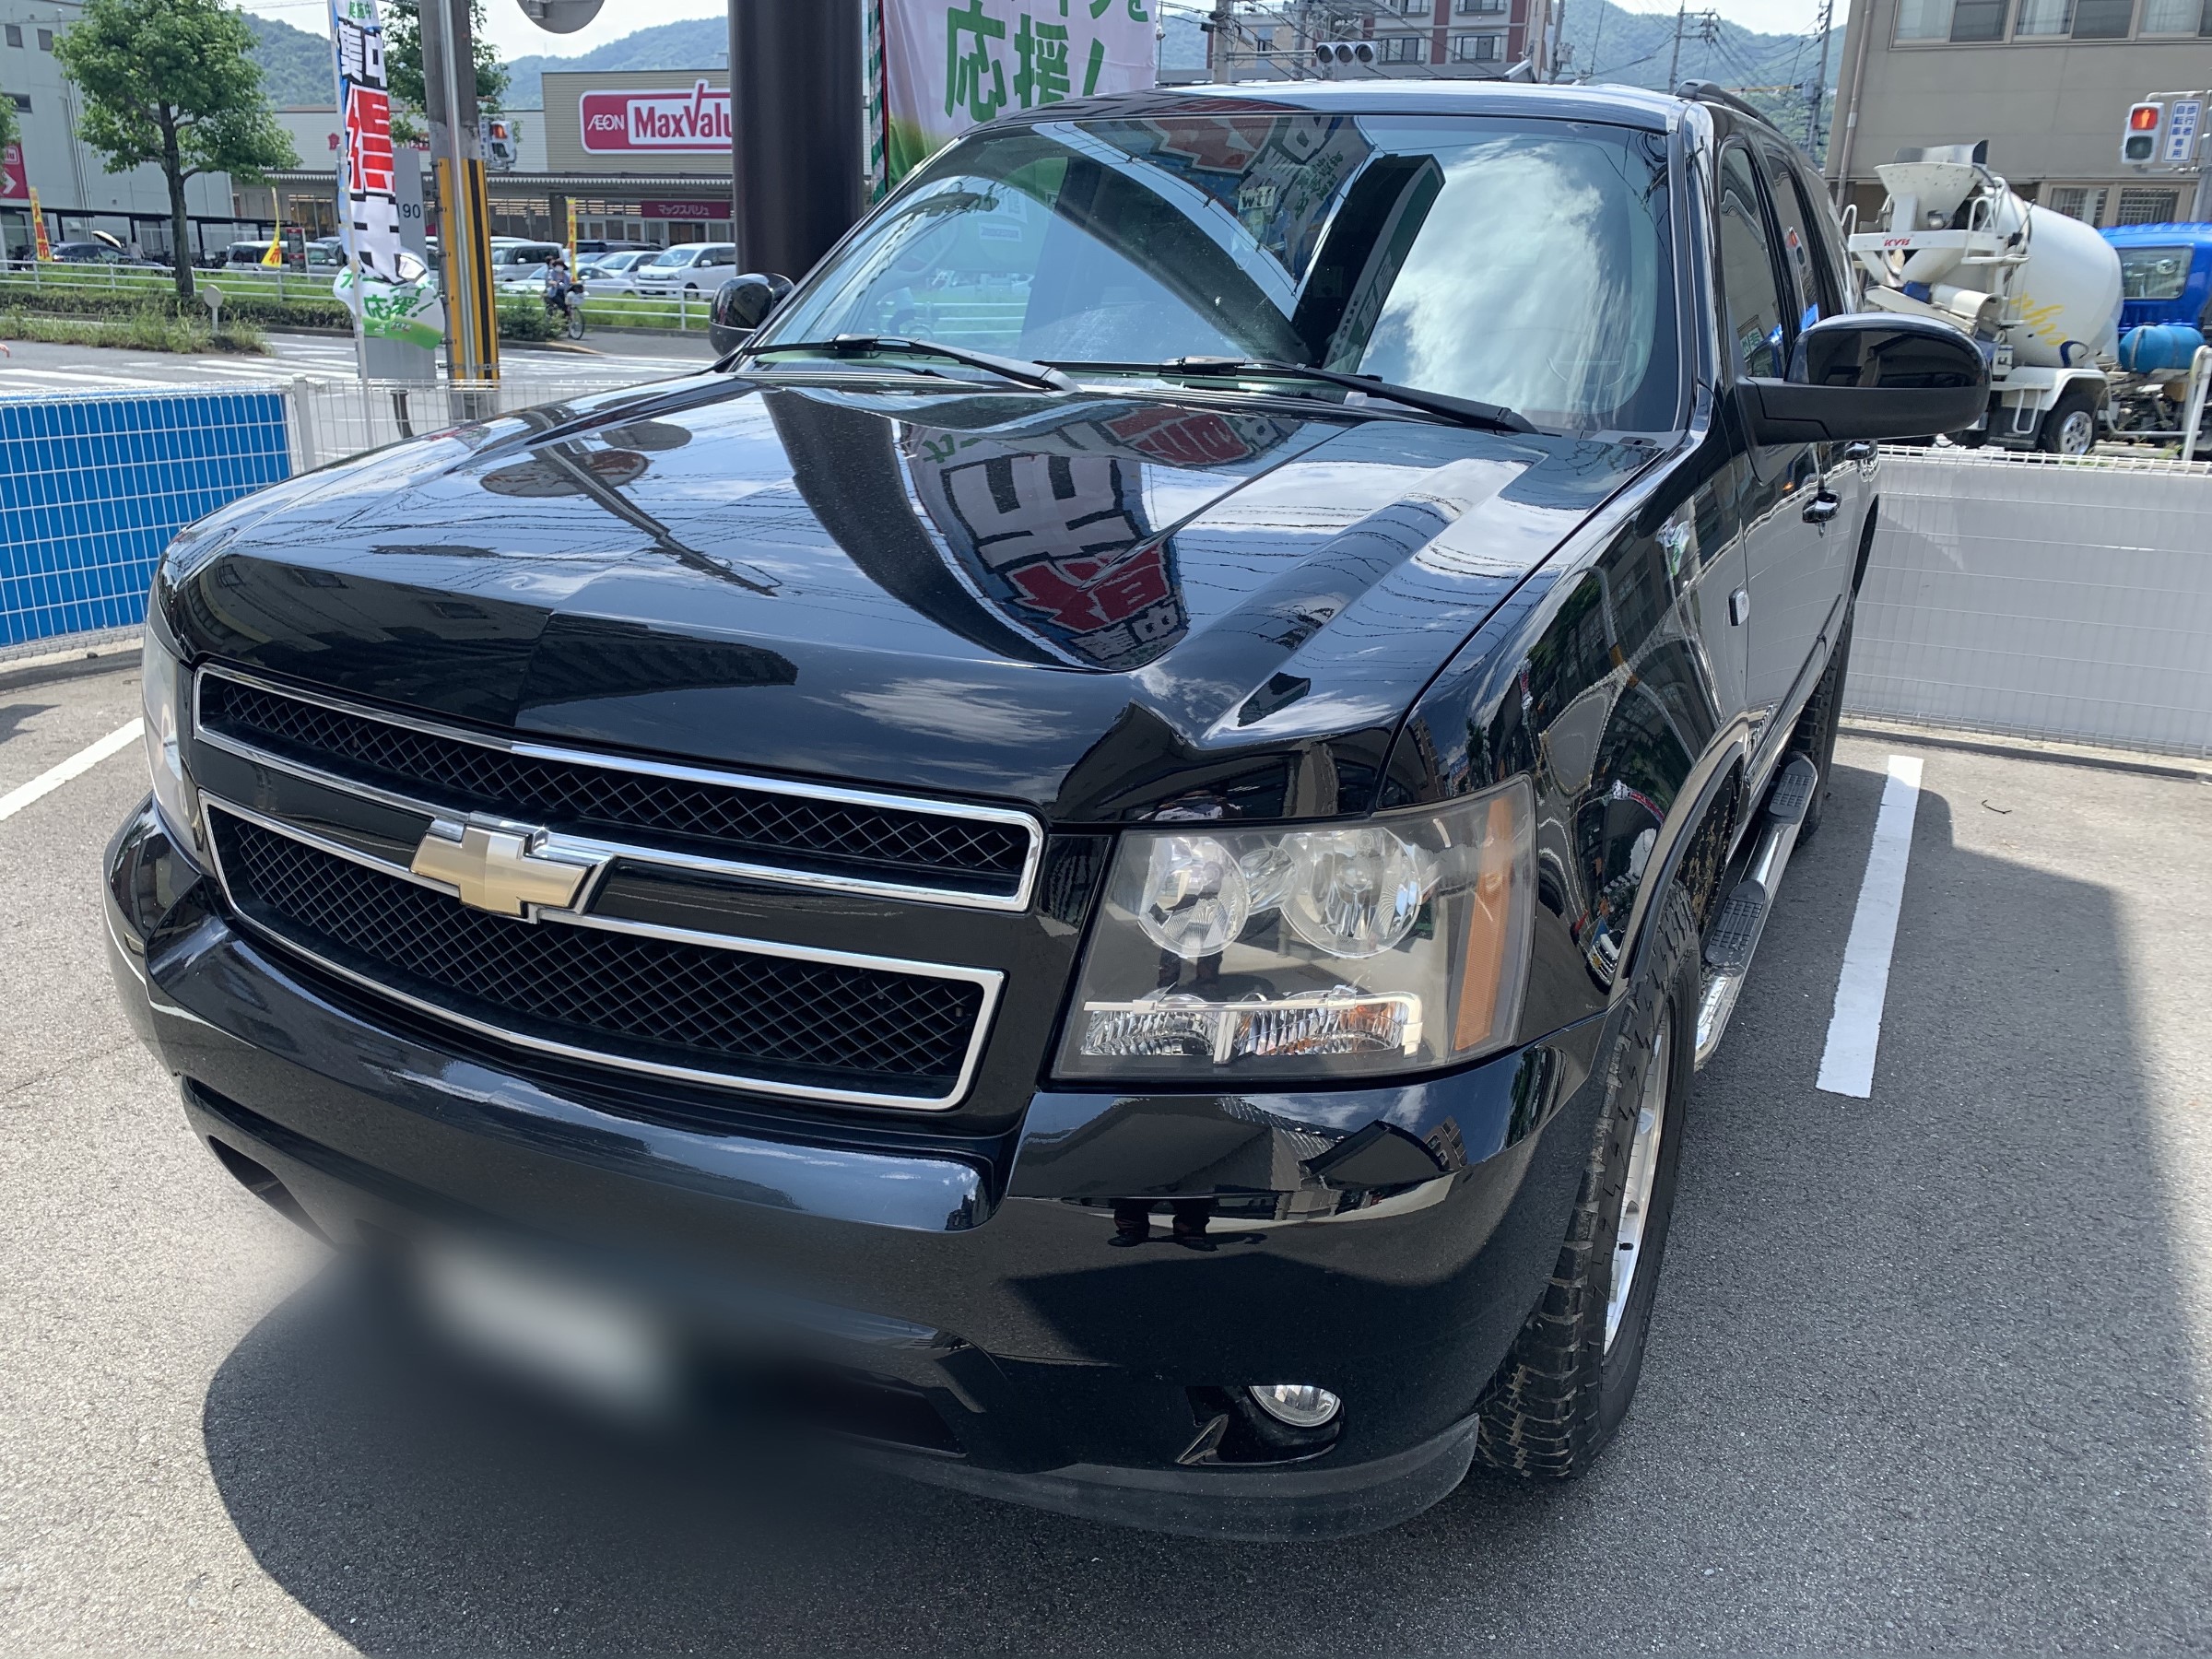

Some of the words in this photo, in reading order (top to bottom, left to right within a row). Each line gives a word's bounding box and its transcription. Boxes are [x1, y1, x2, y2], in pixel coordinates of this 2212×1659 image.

[2171, 105, 2186, 135] 自転車
[2183, 105, 2197, 135] 歩行者
[657, 204, 711, 216] マックスバリュ
